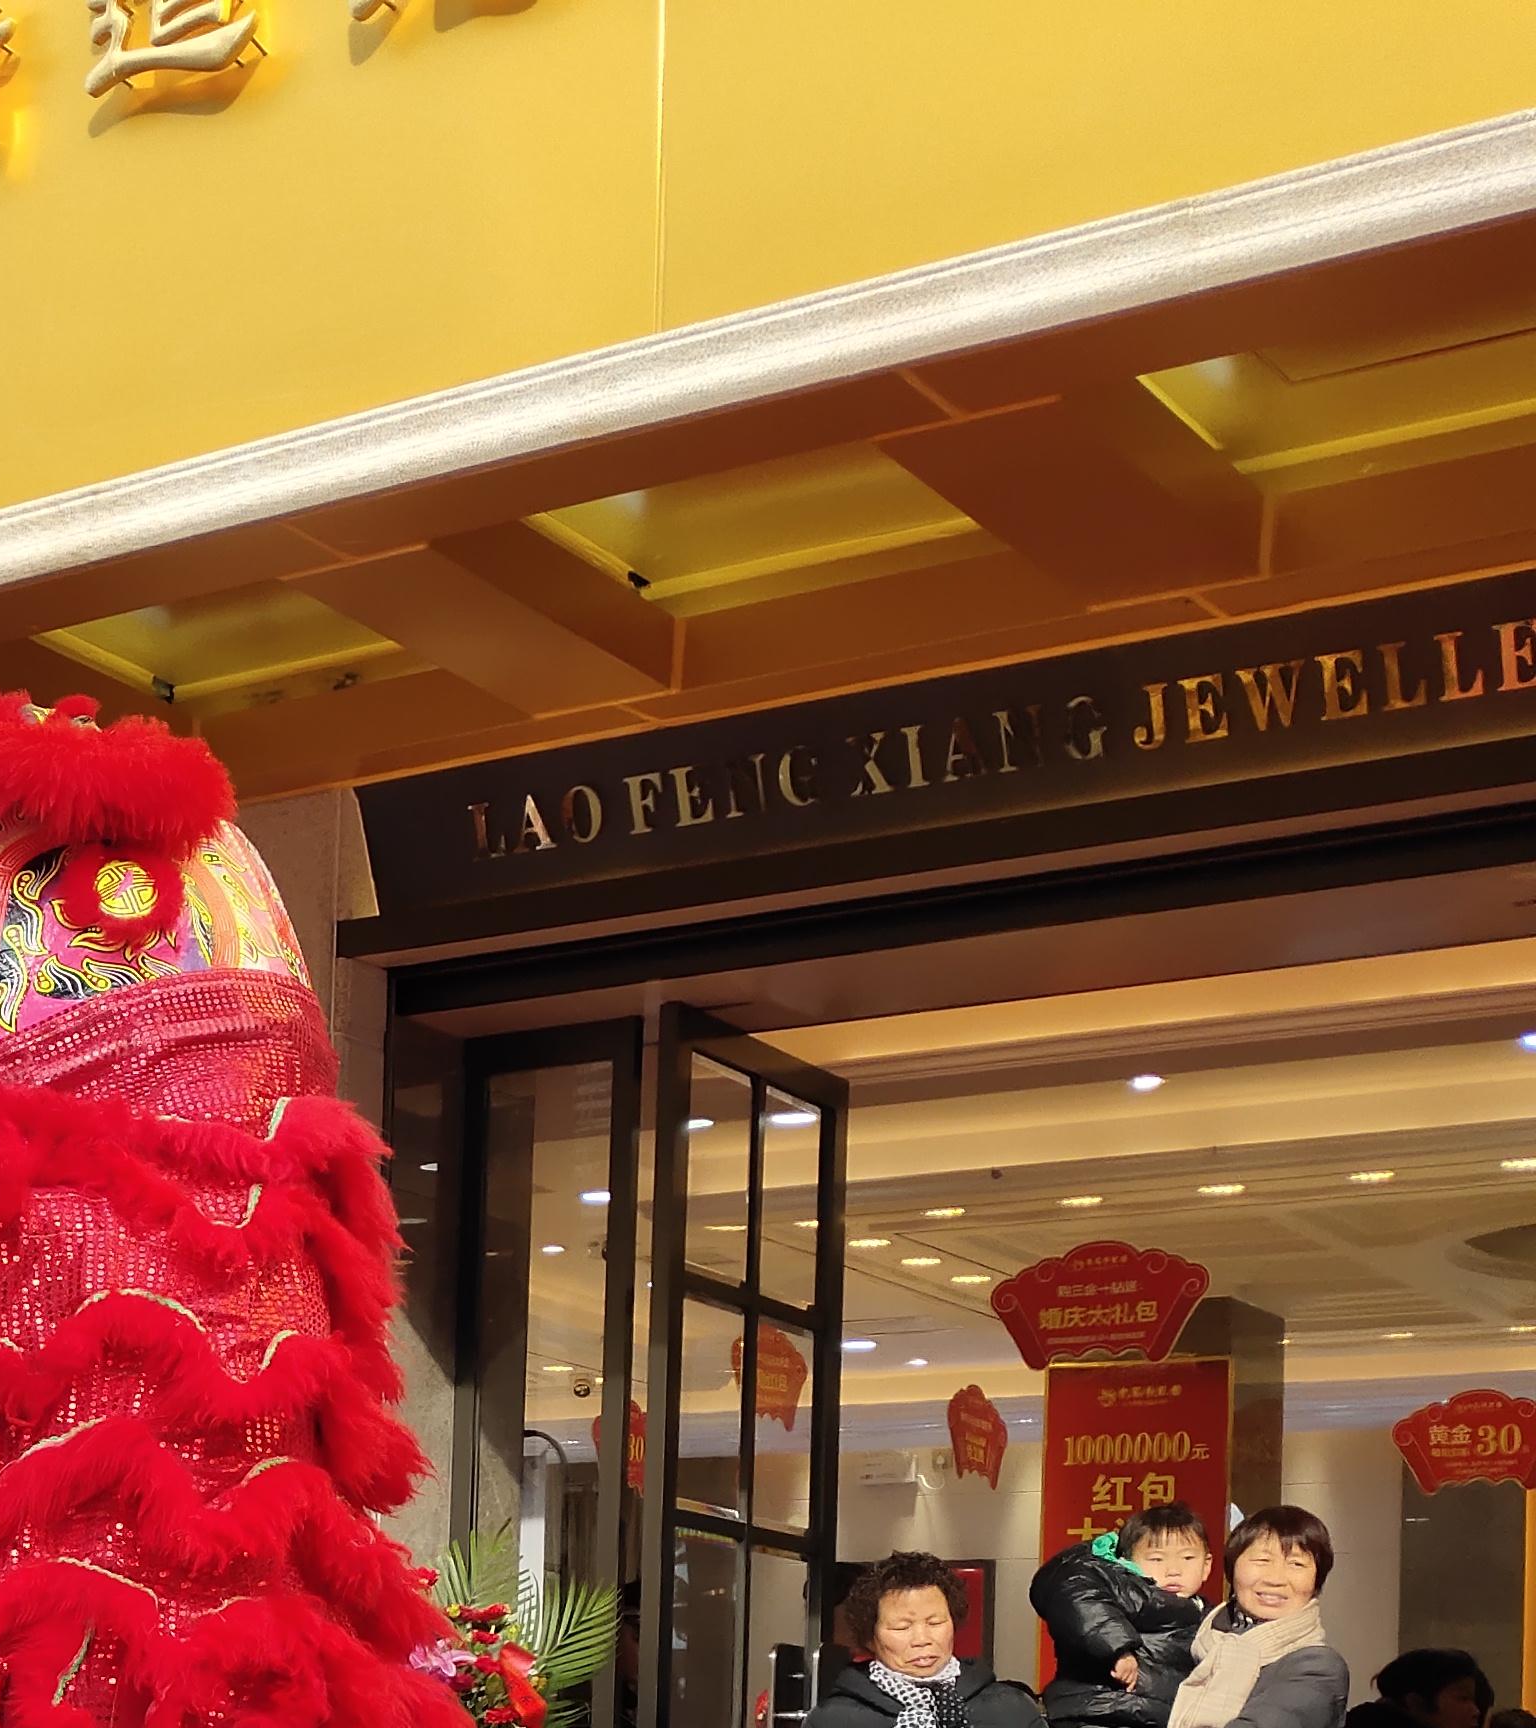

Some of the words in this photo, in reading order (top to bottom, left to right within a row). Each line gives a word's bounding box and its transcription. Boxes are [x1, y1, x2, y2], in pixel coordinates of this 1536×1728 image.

[466, 793, 604, 861] LAO
[622, 746, 820, 836] FENG
[846, 695, 1109, 798] XIANG
[1091, 1472, 1176, 1512] 红包
